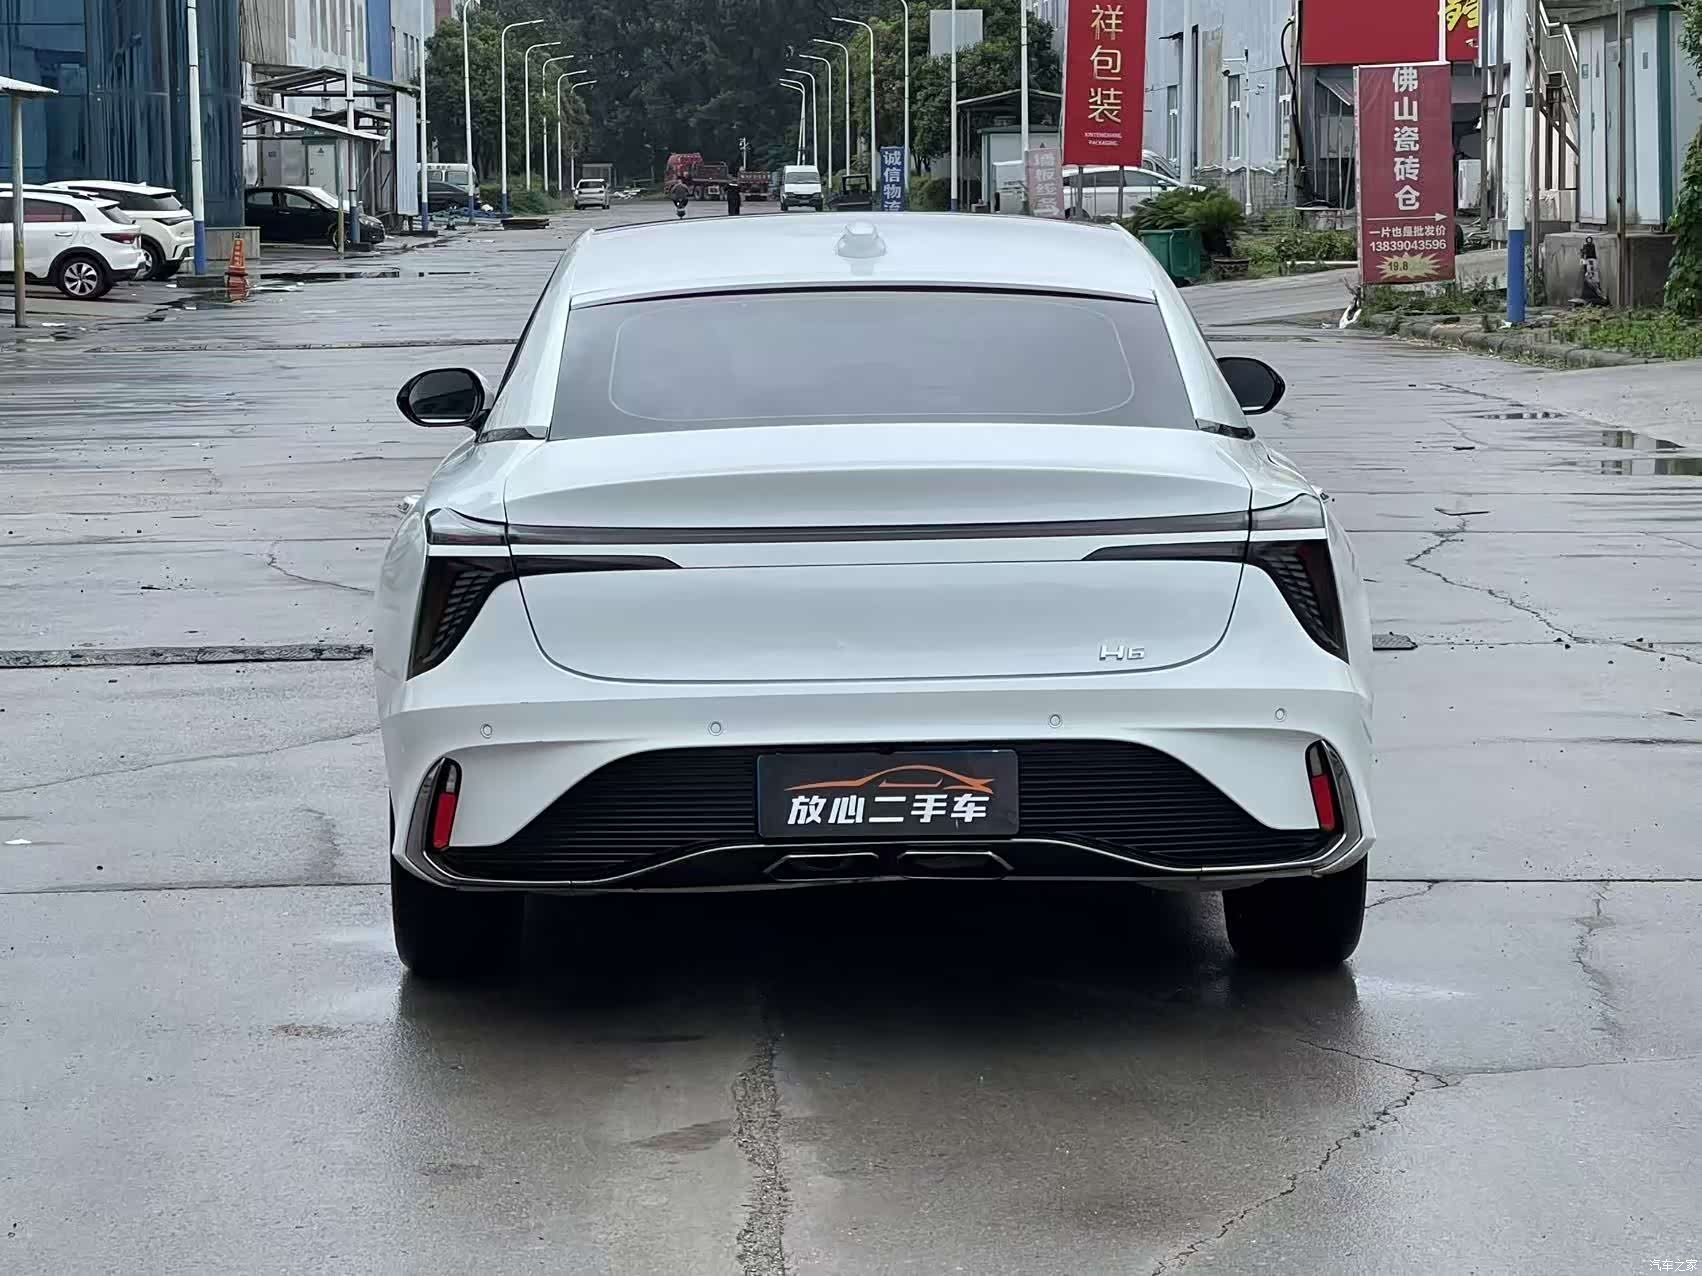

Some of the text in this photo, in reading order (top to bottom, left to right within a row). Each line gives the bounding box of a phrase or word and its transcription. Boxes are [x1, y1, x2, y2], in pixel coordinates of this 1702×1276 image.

[1088, 4, 1124, 123] 祥包装
[1392, 66, 1420, 211] 佛山瓷砖仓
[1368, 225, 1447, 238] 一片也是批发价
[1369, 239, 1447, 252] 13839043596
[1099, 645, 1145, 661] H6
[787, 793, 990, 825] 放心二手车
